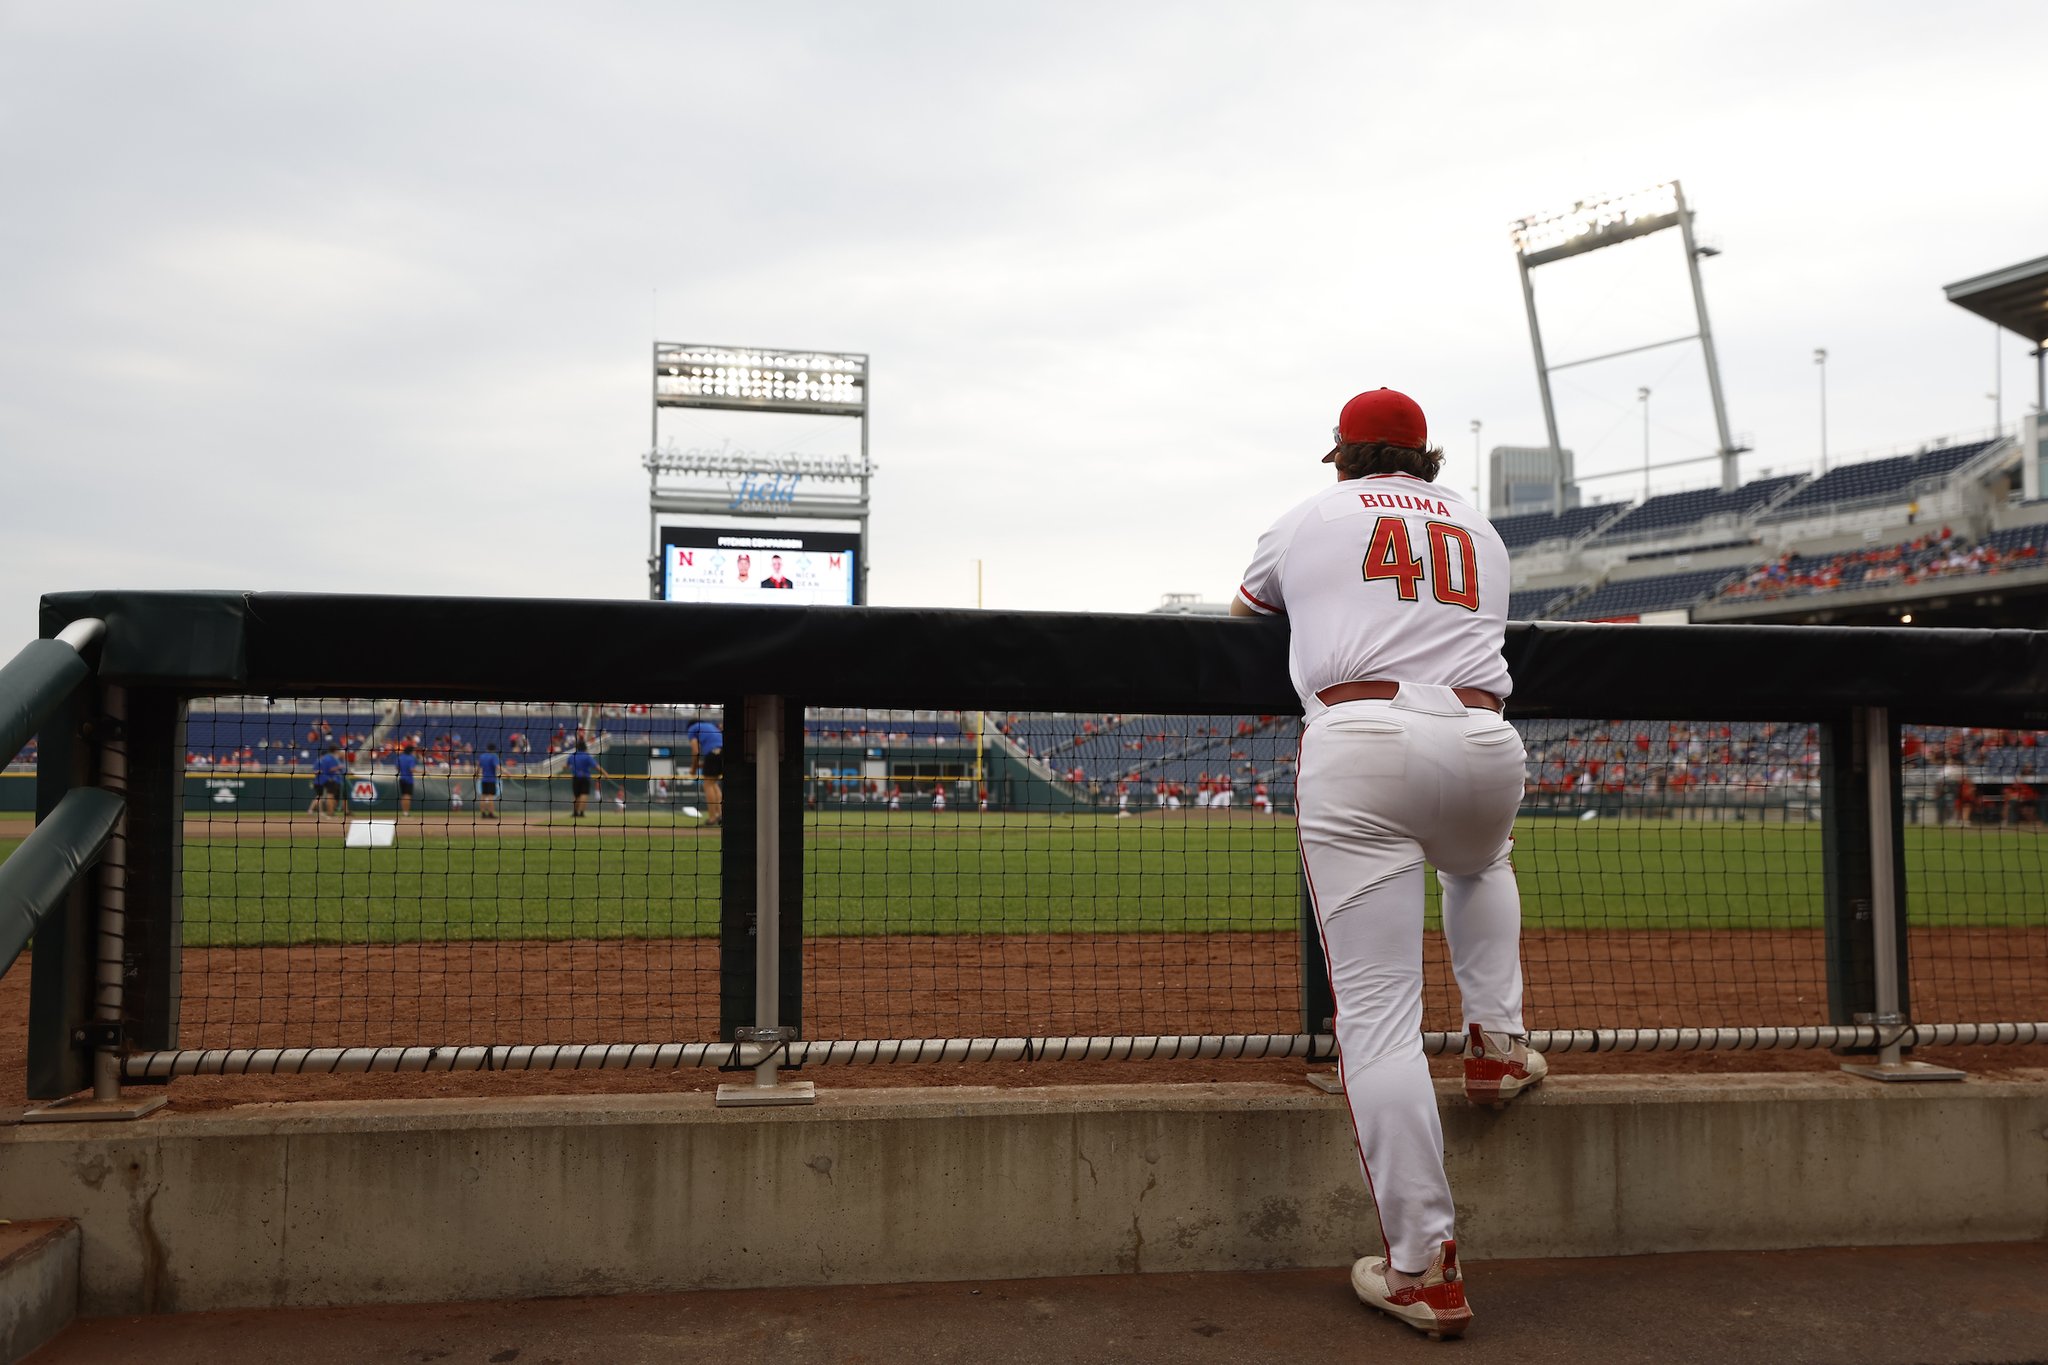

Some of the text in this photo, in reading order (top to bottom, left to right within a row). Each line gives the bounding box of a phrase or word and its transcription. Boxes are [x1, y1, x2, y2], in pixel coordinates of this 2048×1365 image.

[727, 471, 801, 510] field
[741, 501, 792, 513] OMAHA
[1358, 494, 1451, 517] BOUMA
[679, 551, 693, 566] N
[1362, 516, 1480, 612] 40
